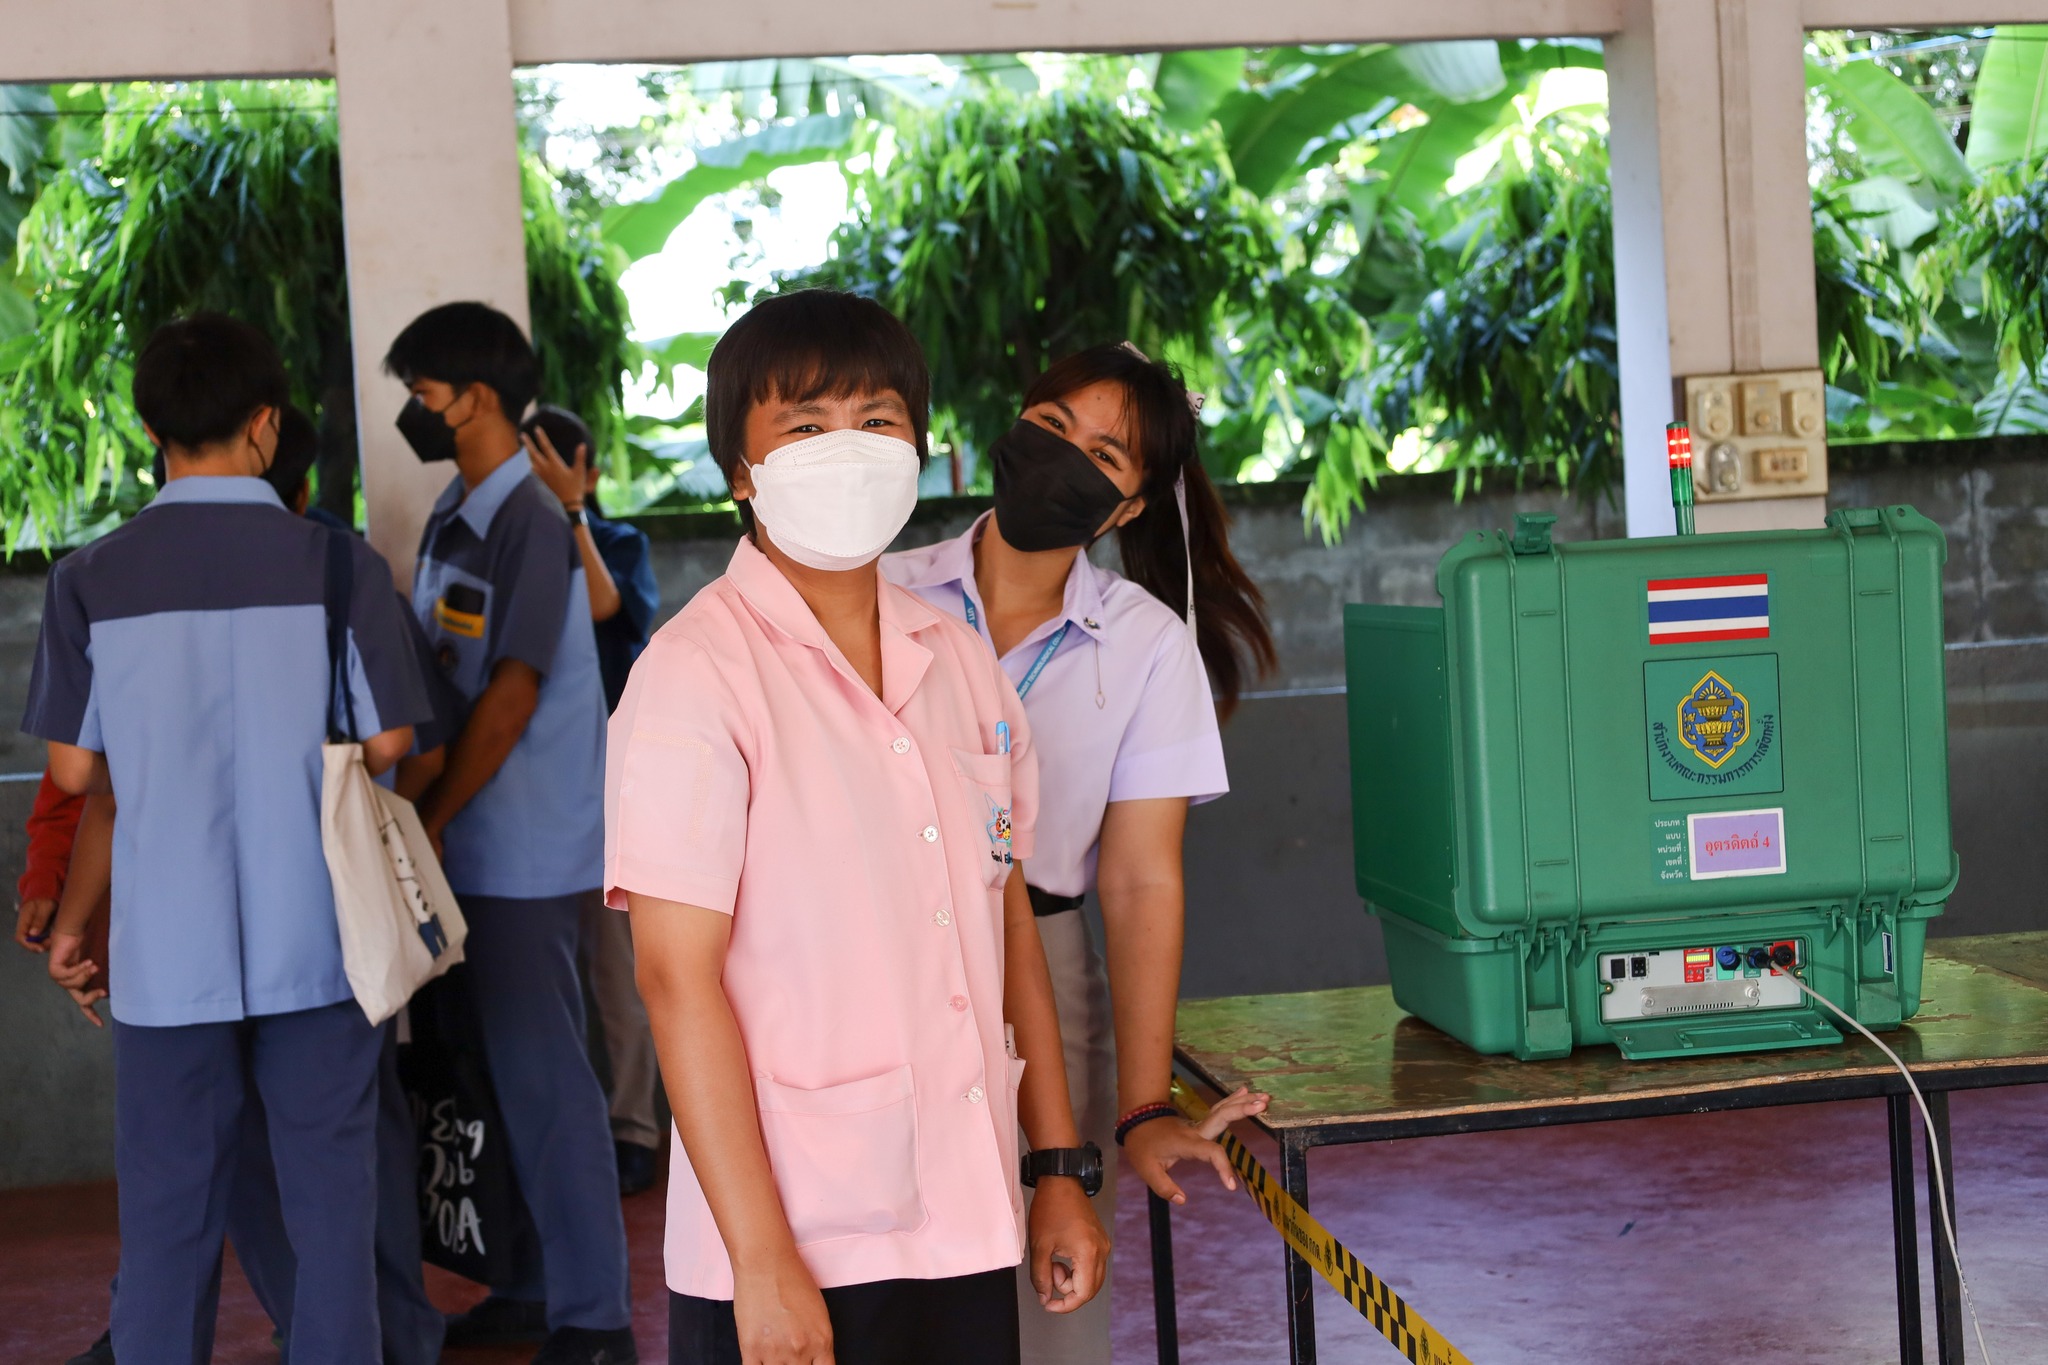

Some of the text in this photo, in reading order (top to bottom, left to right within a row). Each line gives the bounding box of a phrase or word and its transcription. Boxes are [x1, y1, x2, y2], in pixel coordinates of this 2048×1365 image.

[1653, 714, 1774, 785] สำนักงานคณะกรรมการการเลือกตั้ง
[1655, 819, 1680, 828] ประเภท
[1665, 832, 1681, 840] แบบ
[1657, 841, 1682, 853] หน่วยที่
[1705, 830, 1770, 857] อุตรดิตถ์ 4
[1660, 869, 1684, 880] จังหวัด
